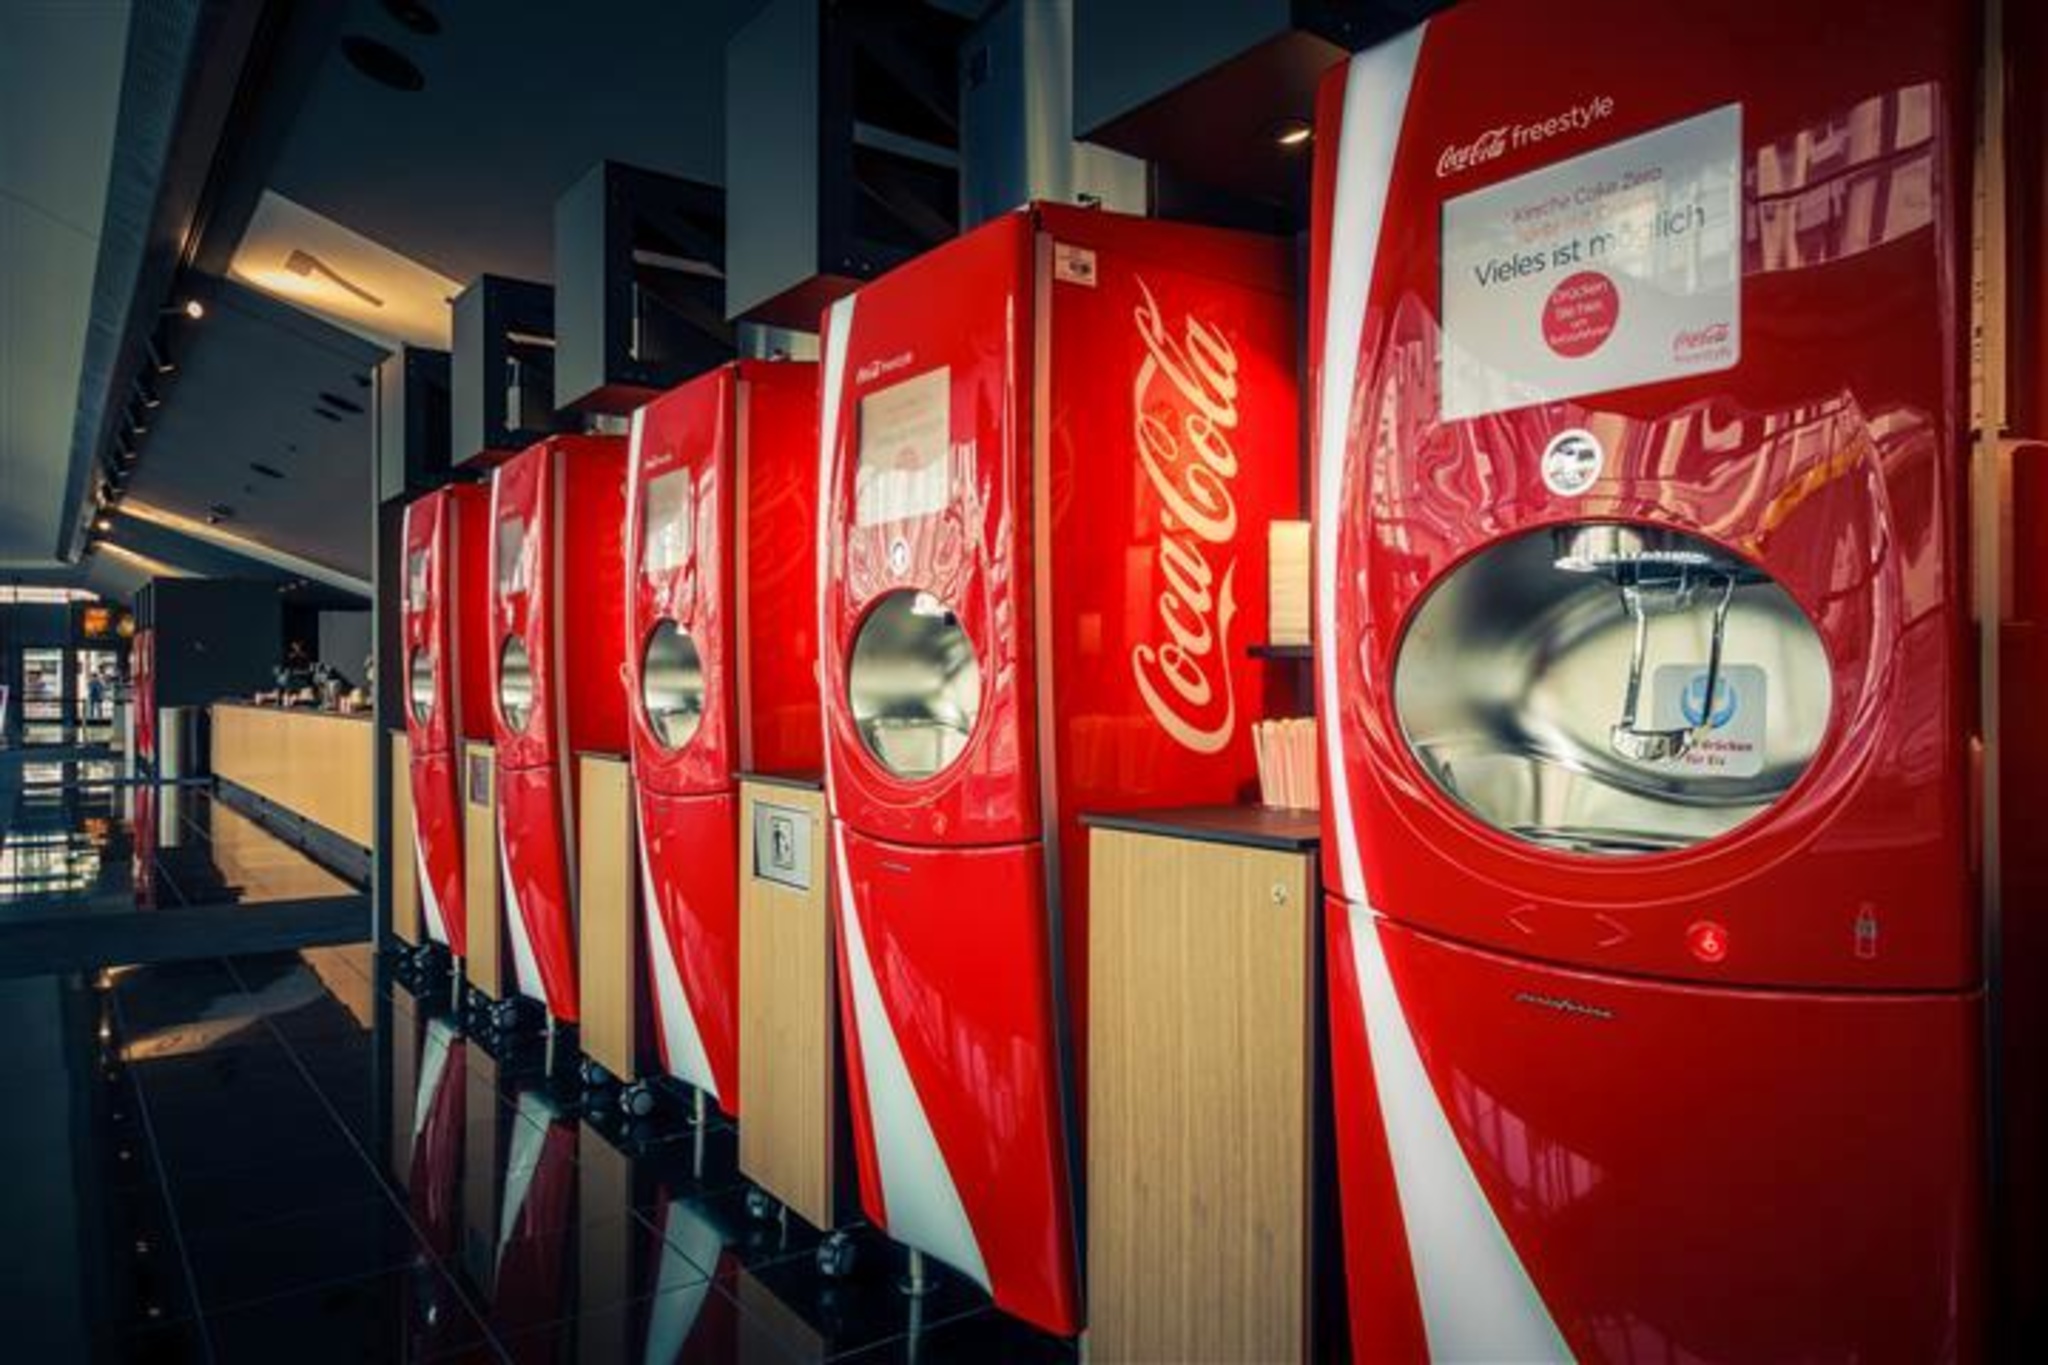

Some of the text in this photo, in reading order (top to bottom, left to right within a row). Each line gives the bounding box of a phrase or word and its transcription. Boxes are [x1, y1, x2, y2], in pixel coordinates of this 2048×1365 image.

[1511, 95, 1614, 150] freestyle
[1474, 249, 1546, 287] Vieles
[1551, 237, 1581, 270] ist
